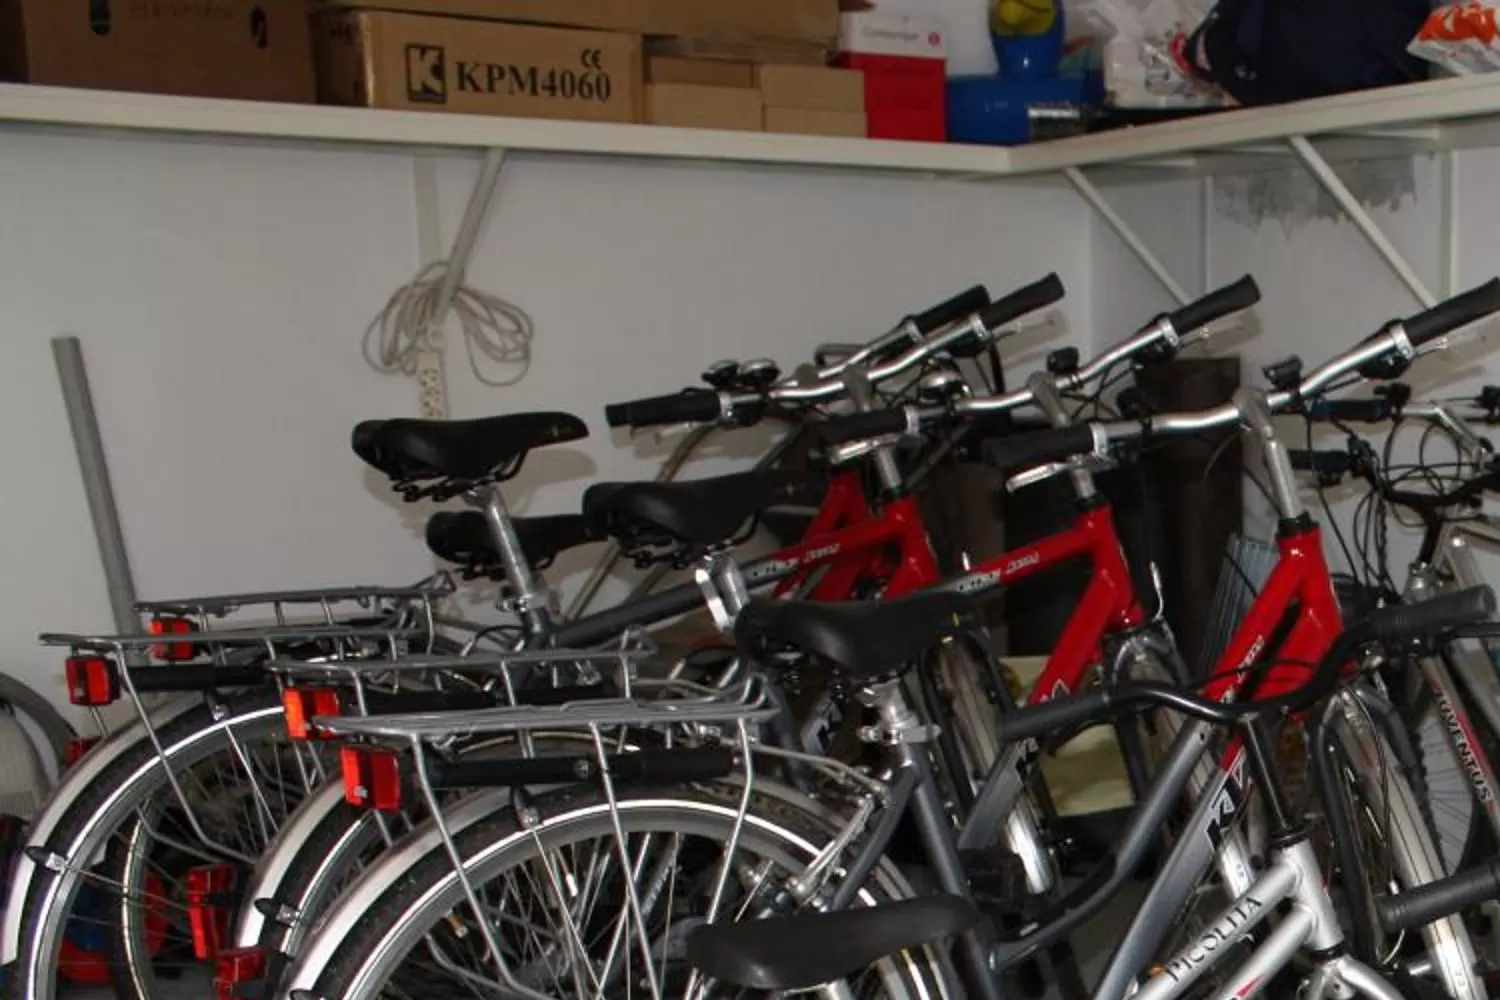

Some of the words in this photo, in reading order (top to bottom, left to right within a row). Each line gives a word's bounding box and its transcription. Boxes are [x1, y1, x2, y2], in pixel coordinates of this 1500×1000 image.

[454, 60, 612, 104] KPM4060
[1433, 687, 1492, 802] JUVENTUS
[1164, 896, 1262, 983] PICOLITA
